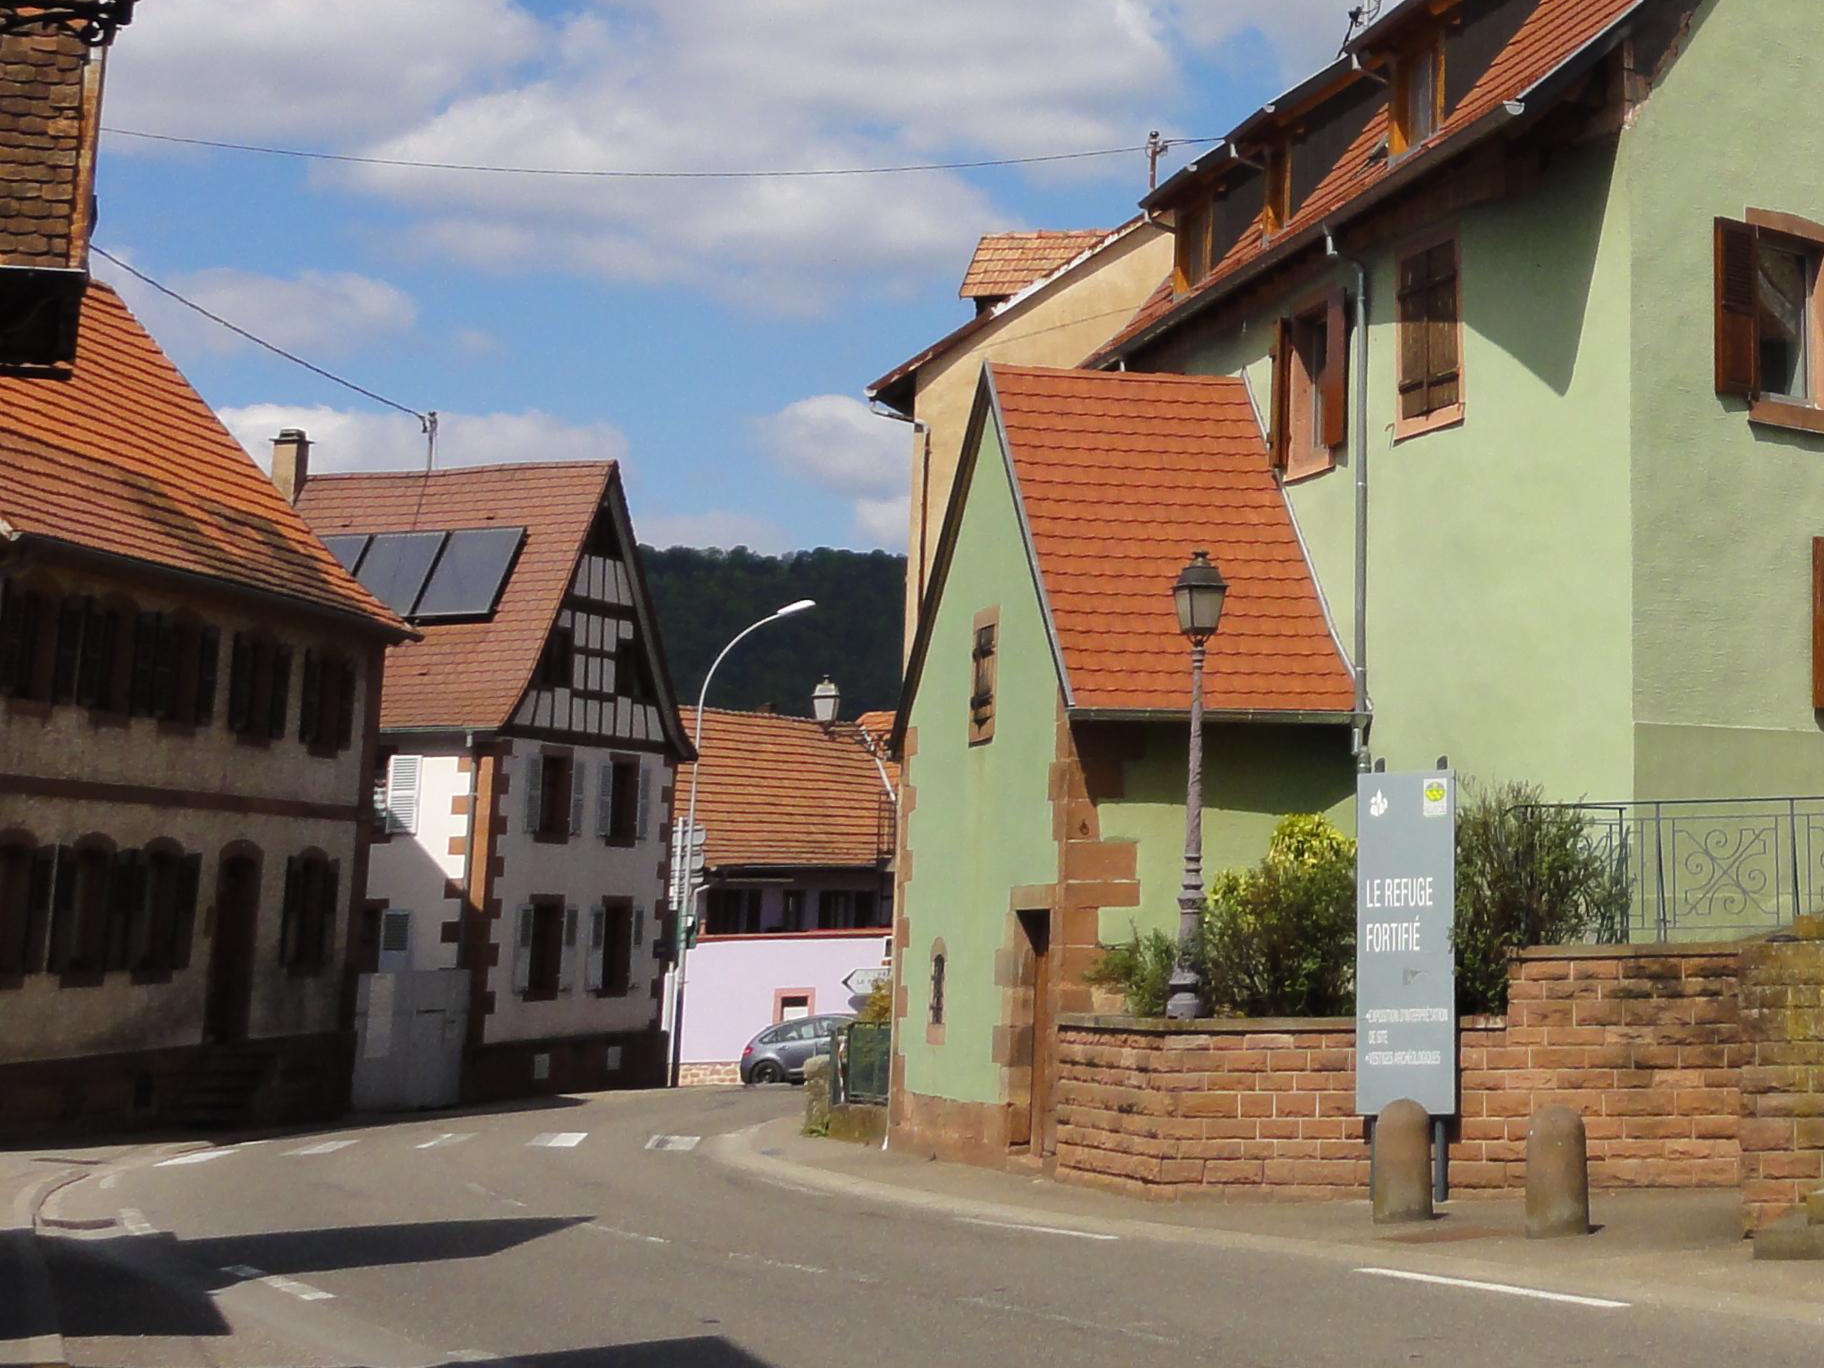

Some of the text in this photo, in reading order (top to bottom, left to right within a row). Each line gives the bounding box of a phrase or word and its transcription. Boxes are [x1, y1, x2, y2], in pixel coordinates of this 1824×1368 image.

[1366, 877, 1433, 908] LE REFUGE
[1366, 914, 1420, 952] FORTIFIÉ
